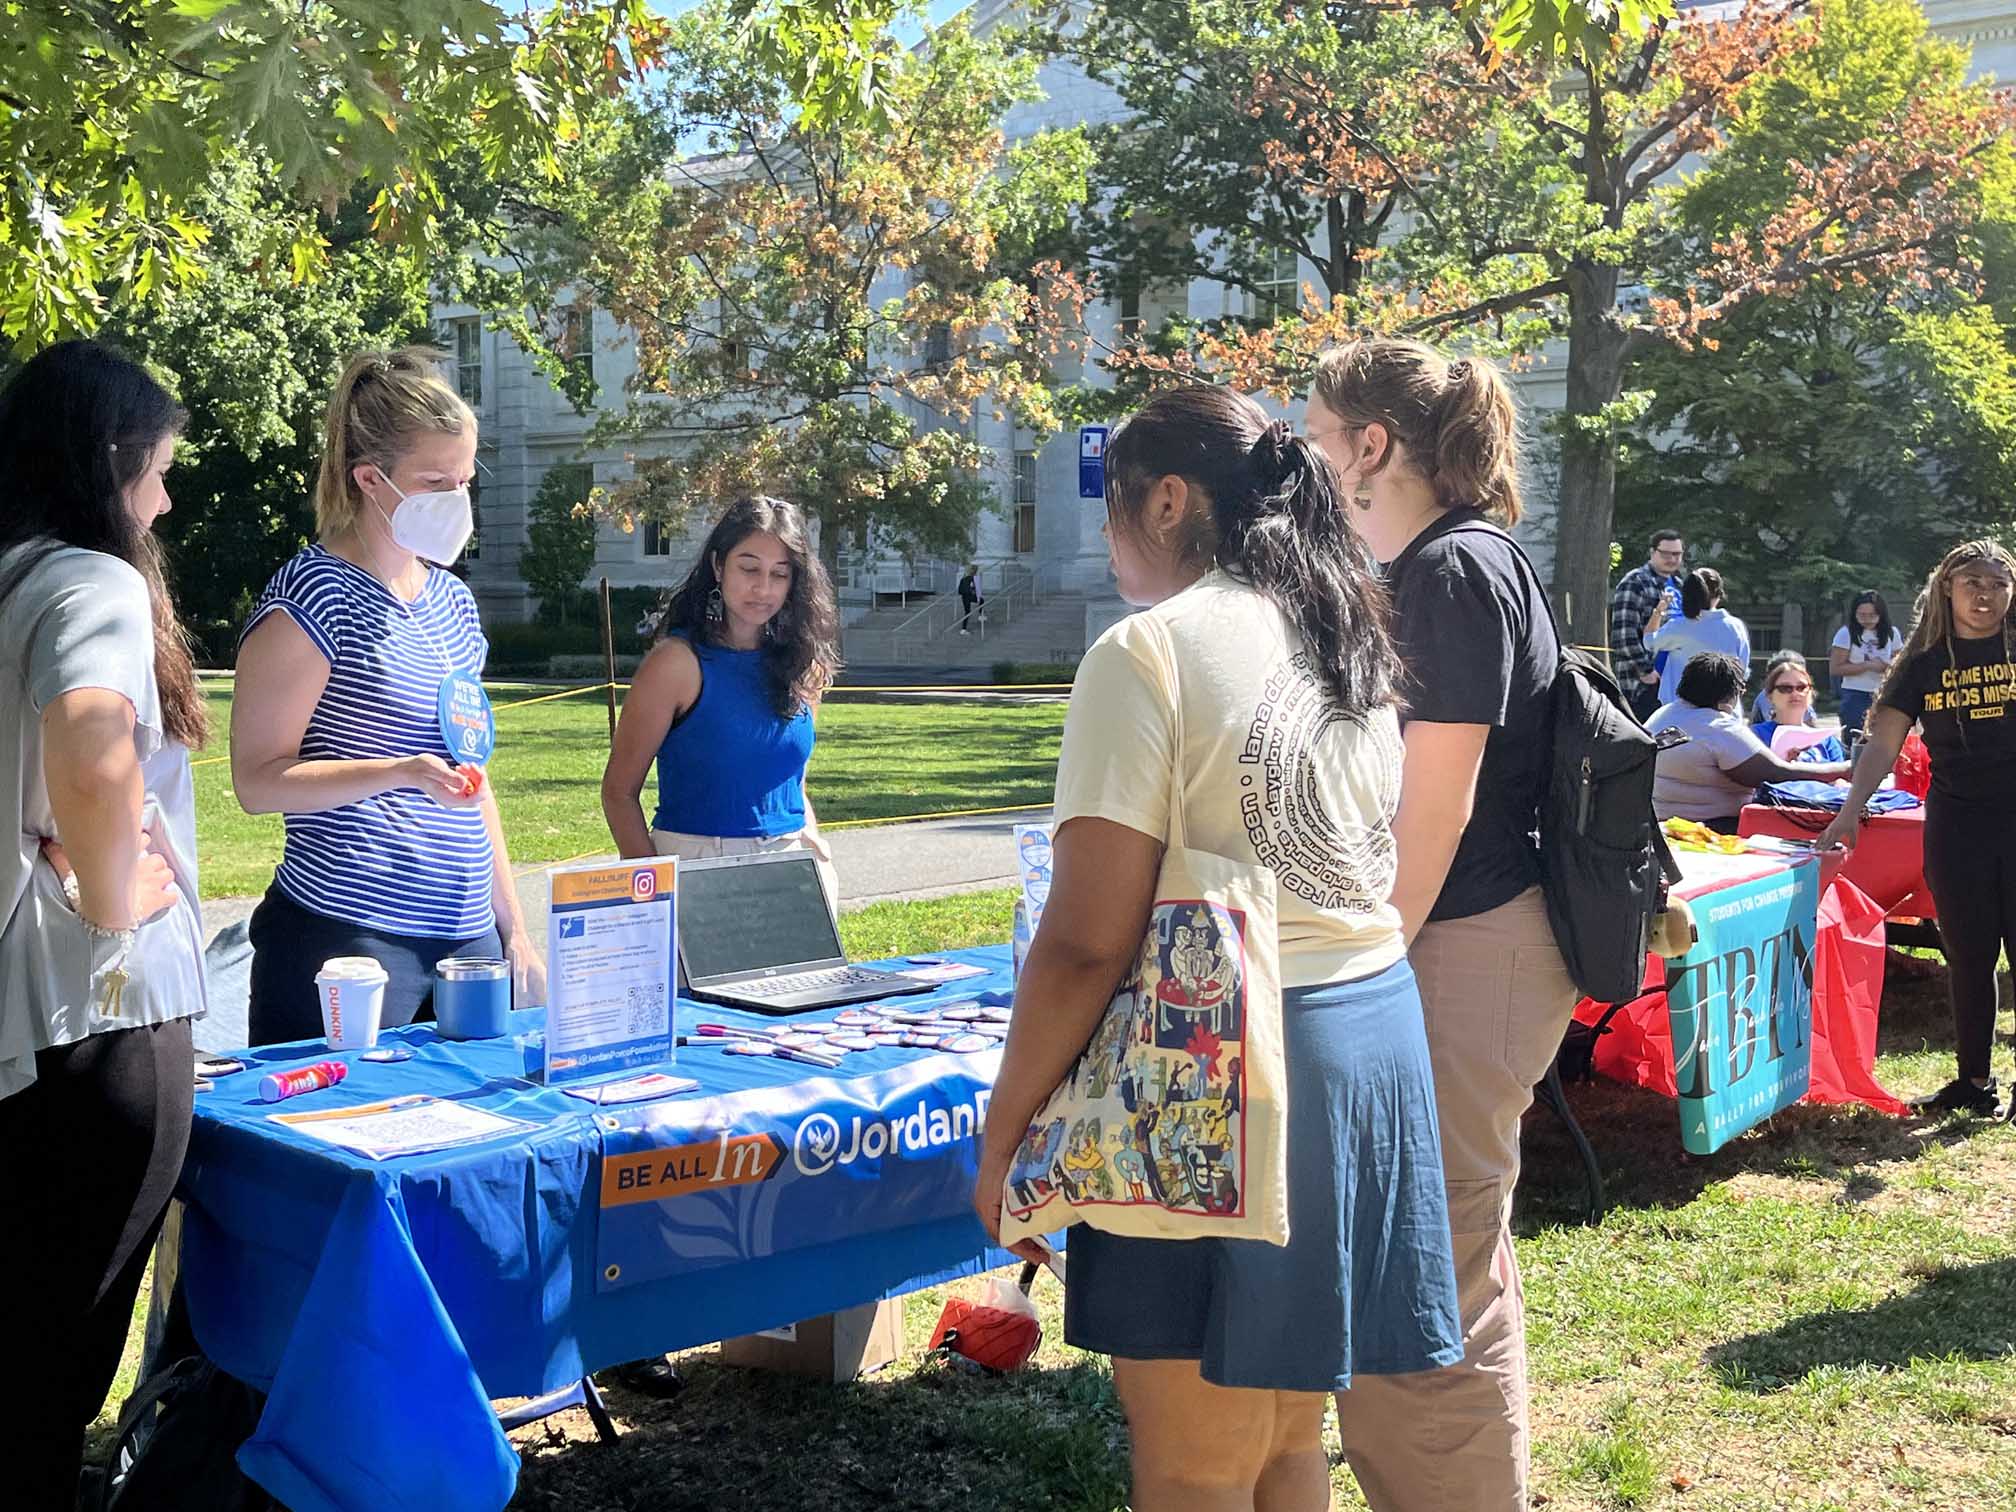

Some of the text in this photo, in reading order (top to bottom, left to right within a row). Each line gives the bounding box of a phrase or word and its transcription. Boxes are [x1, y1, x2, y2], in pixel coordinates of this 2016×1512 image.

[1983, 663, 2016, 682] HOM
[1238, 702, 1273, 764] lana
[1264, 662, 1292, 703] del
[1287, 651, 1314, 676] rey
[1924, 692, 1944, 712] THE
[1945, 688, 1980, 708] KDS
[1972, 707, 2002, 717] TOUR
[1264, 727, 1285, 817] dayglow
[1240, 792, 1292, 880] jepsen
[1277, 829, 1325, 877] parks
[1282, 872, 1326, 906] rae
[1319, 869, 1354, 891] arlo
[1325, 890, 1377, 913] carly
[329, 986, 343, 1042] DUNKIN'
[1695, 1121, 1706, 1135] A
[617, 1129, 764, 1190] BE ALL In
